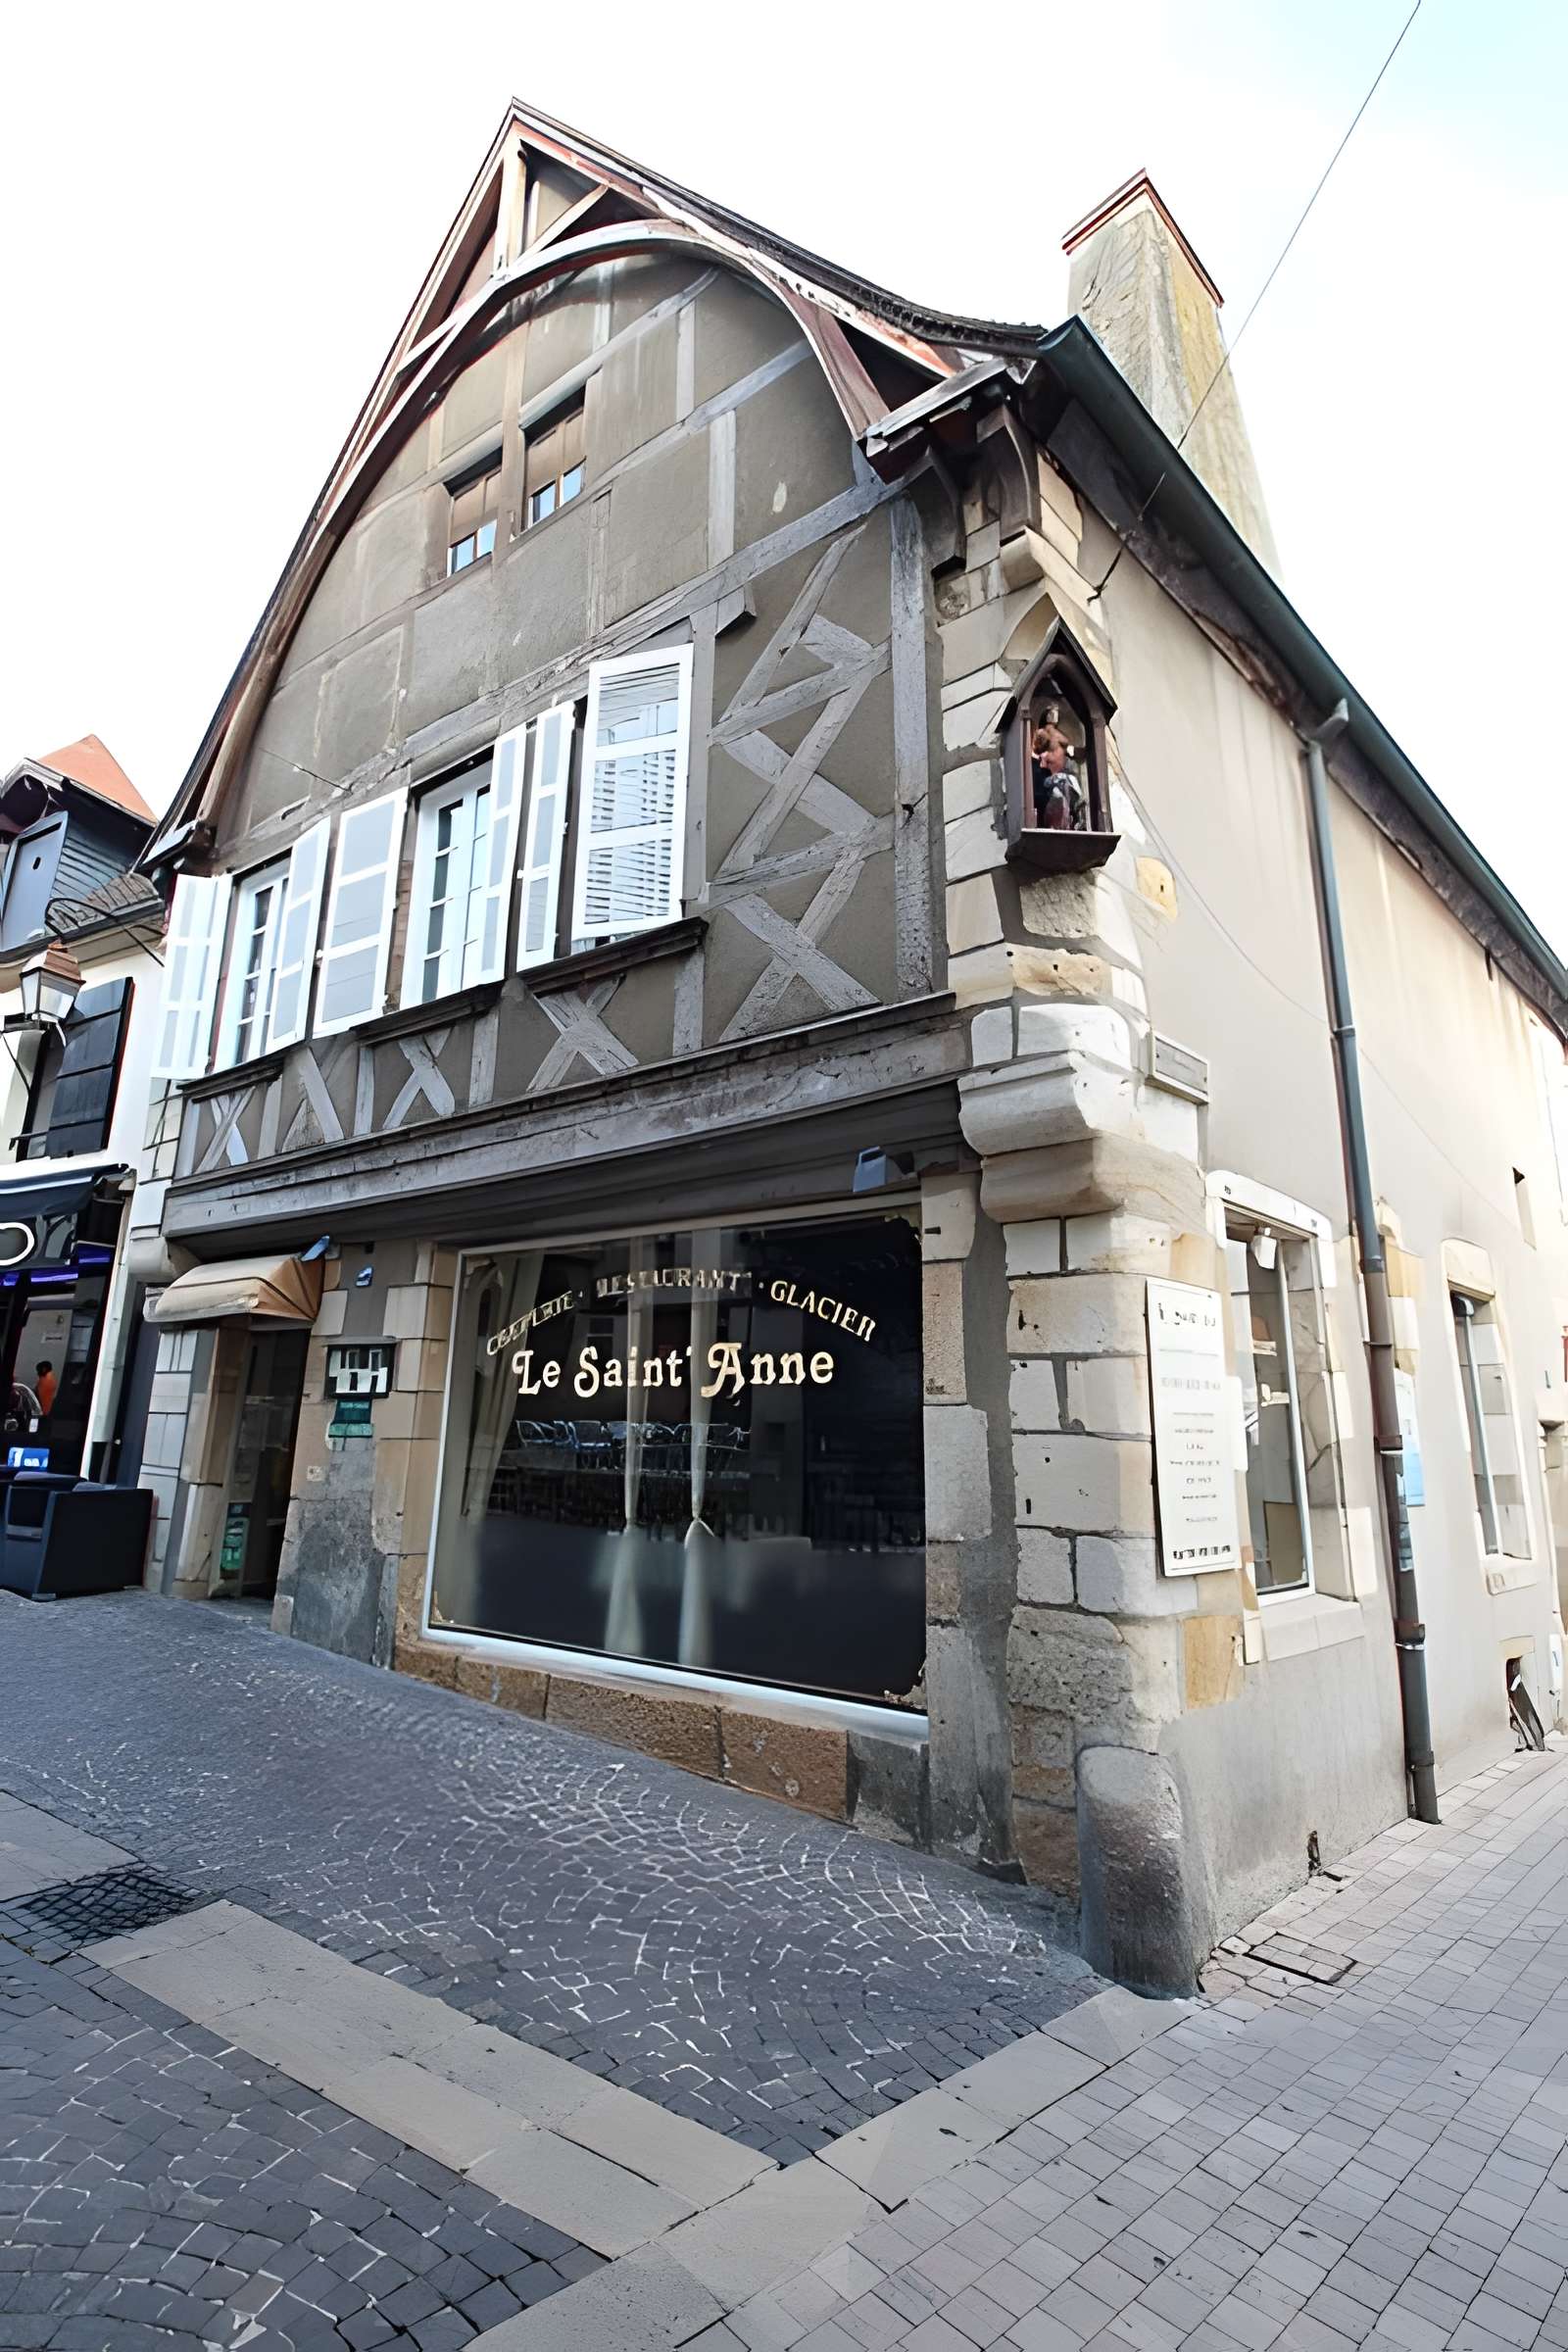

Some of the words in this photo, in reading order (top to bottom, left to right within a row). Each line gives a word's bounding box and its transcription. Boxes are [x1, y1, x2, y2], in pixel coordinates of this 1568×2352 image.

[770, 1280, 876, 1342] GLACIER
[512, 1349, 562, 1395] Le
[700, 1342, 835, 1399] Anne
